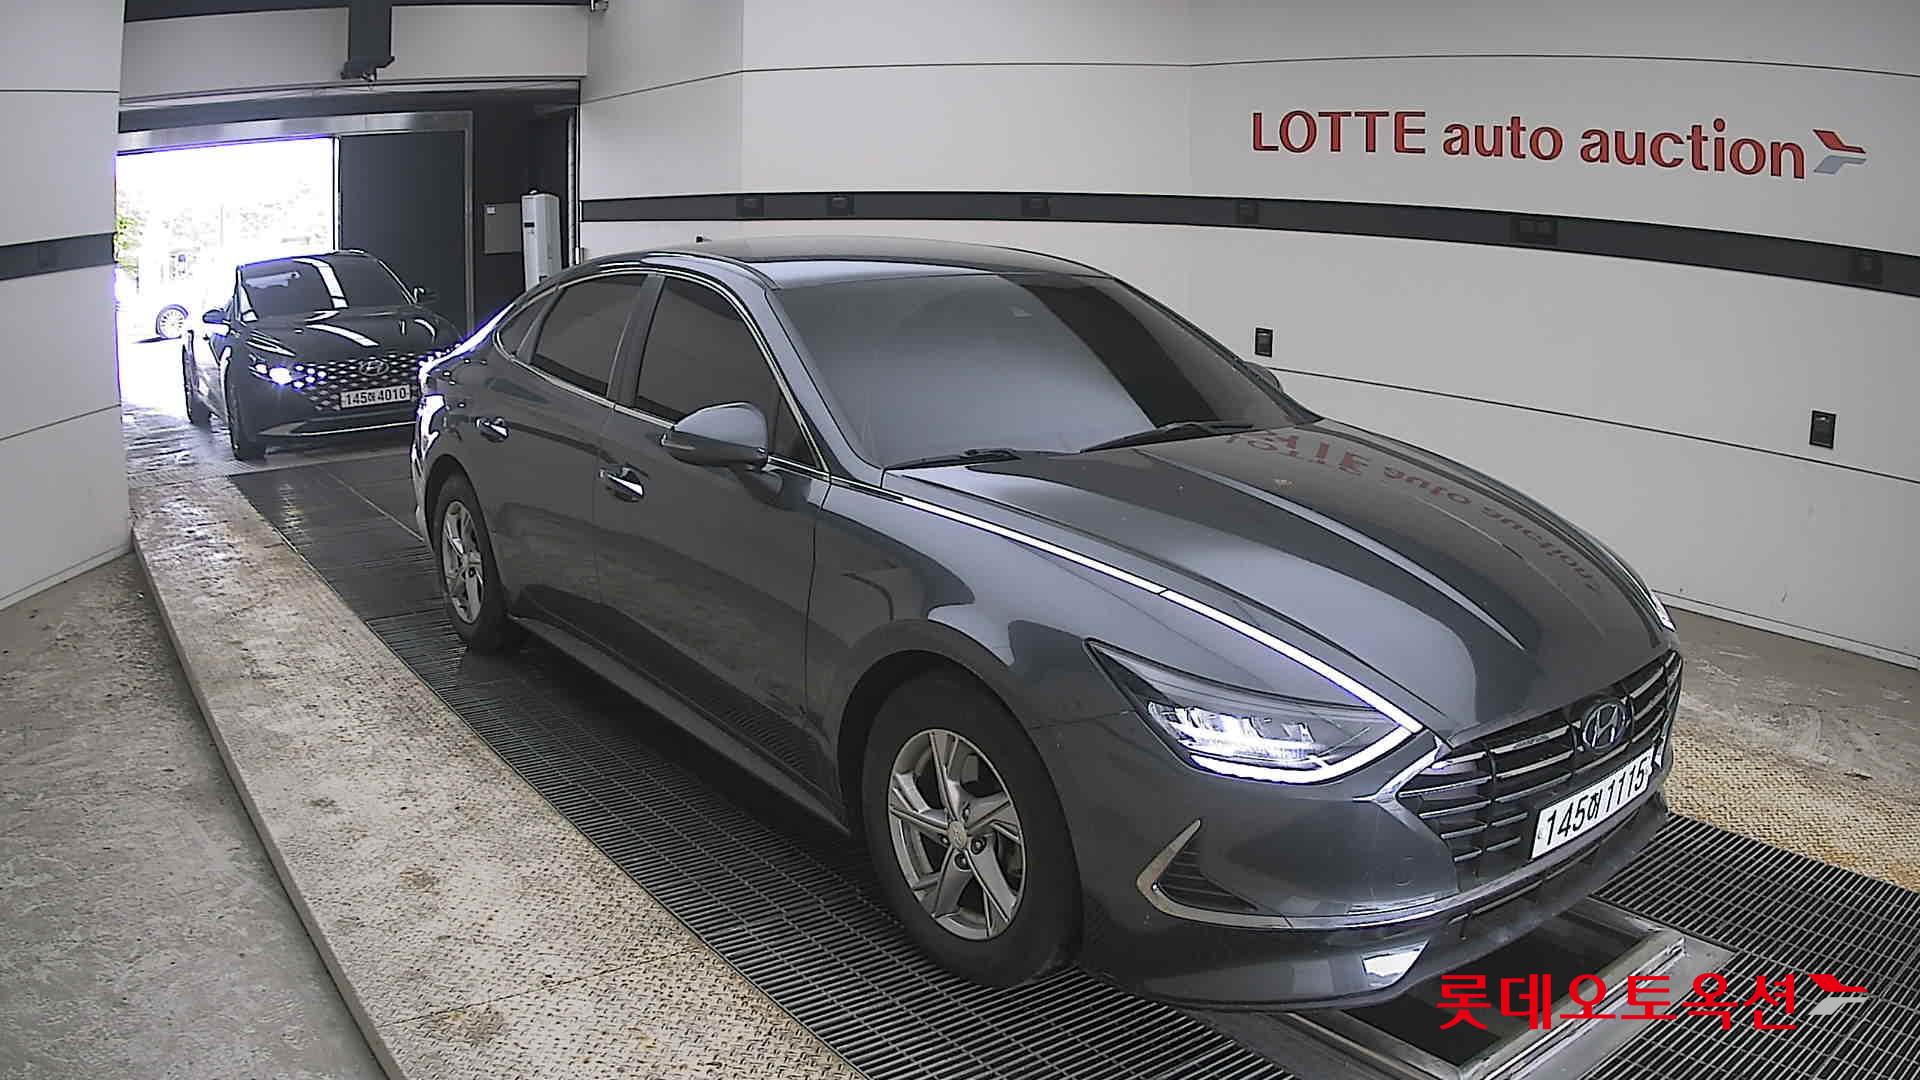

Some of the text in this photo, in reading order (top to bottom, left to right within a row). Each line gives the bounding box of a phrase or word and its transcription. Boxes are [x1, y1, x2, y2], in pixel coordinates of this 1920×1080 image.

[1252, 110, 1806, 179] LOTTE auto auction
[377, 387, 407, 402] 4010
[1605, 757, 1648, 813] 1115
